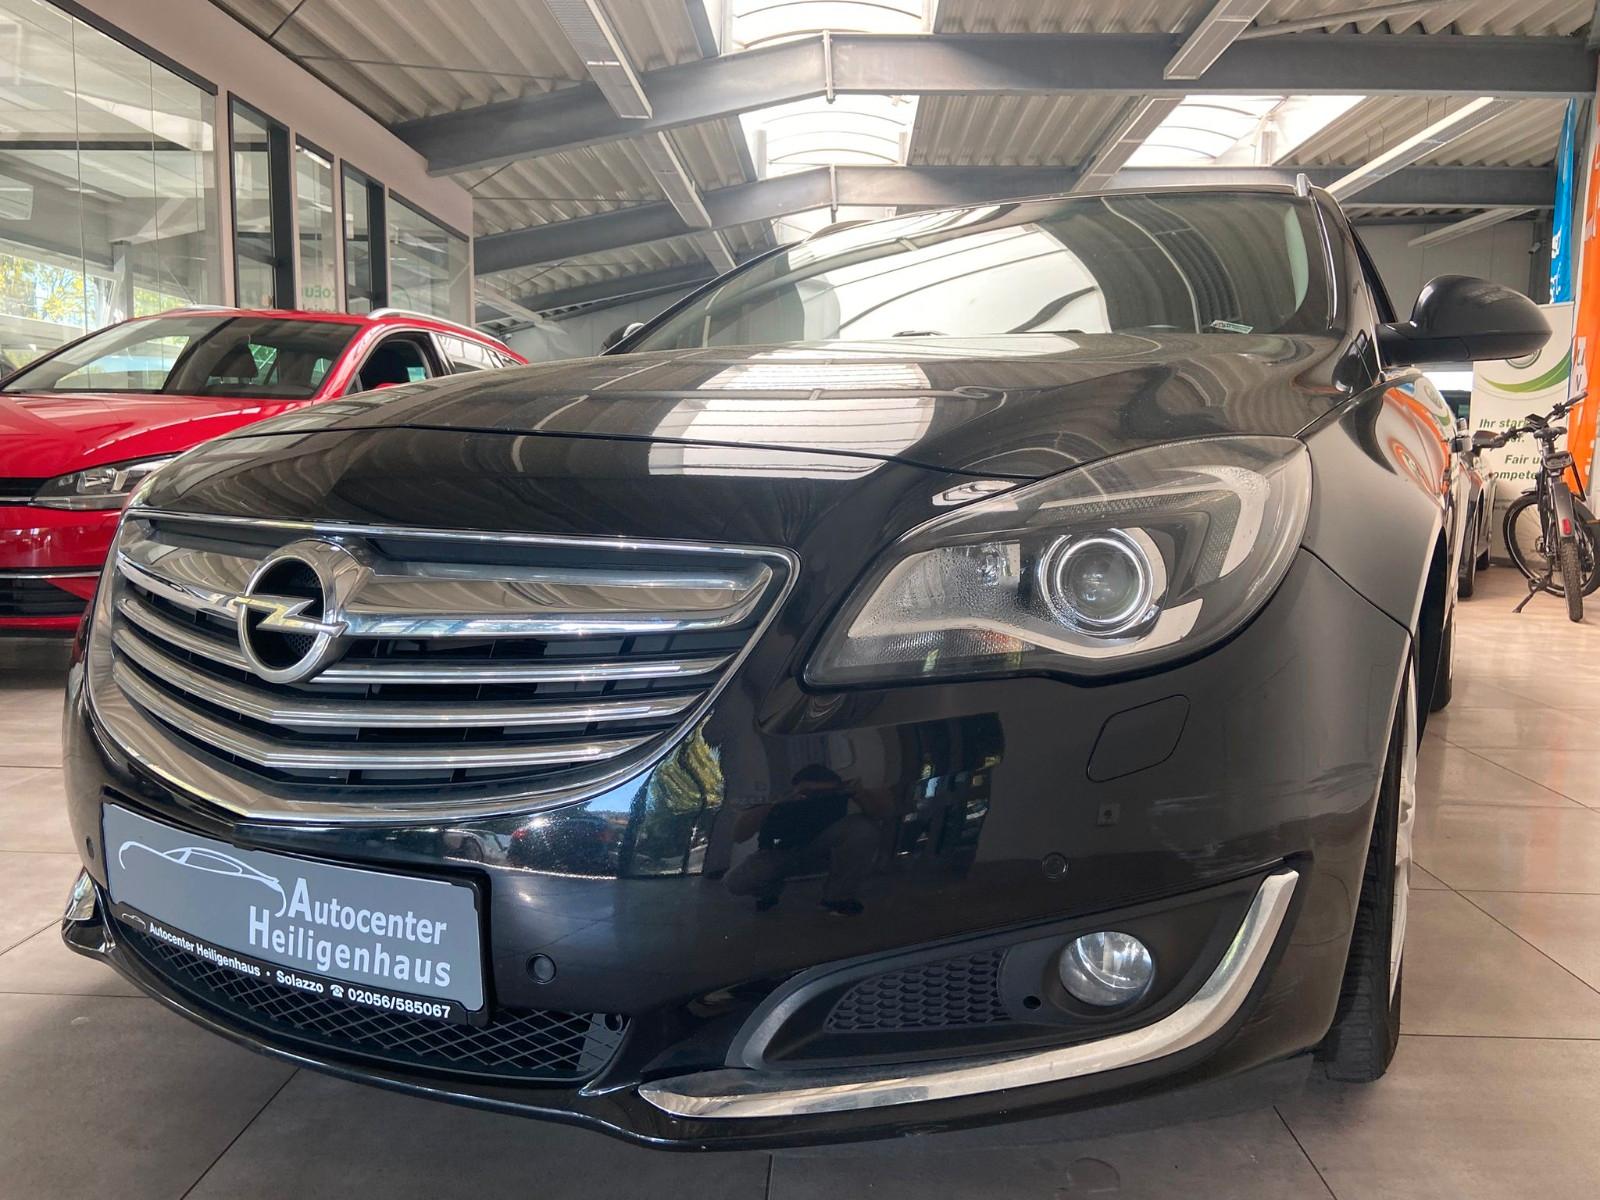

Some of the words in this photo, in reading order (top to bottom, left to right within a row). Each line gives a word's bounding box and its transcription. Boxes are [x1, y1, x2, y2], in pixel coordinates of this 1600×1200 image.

[1479, 418, 1496, 428] Ihr
[1494, 470, 1537, 481] ompete
[1504, 454, 1529, 465] Fair
[288, 877, 447, 945] Autocenter
[248, 905, 452, 988] Heiligenhaus
[149, 921, 195, 954] Autocenter
[196, 942, 261, 977] Heiligenhaus
[276, 969, 324, 993] Solazzo
[347, 988, 451, 1019] 02056/585067
